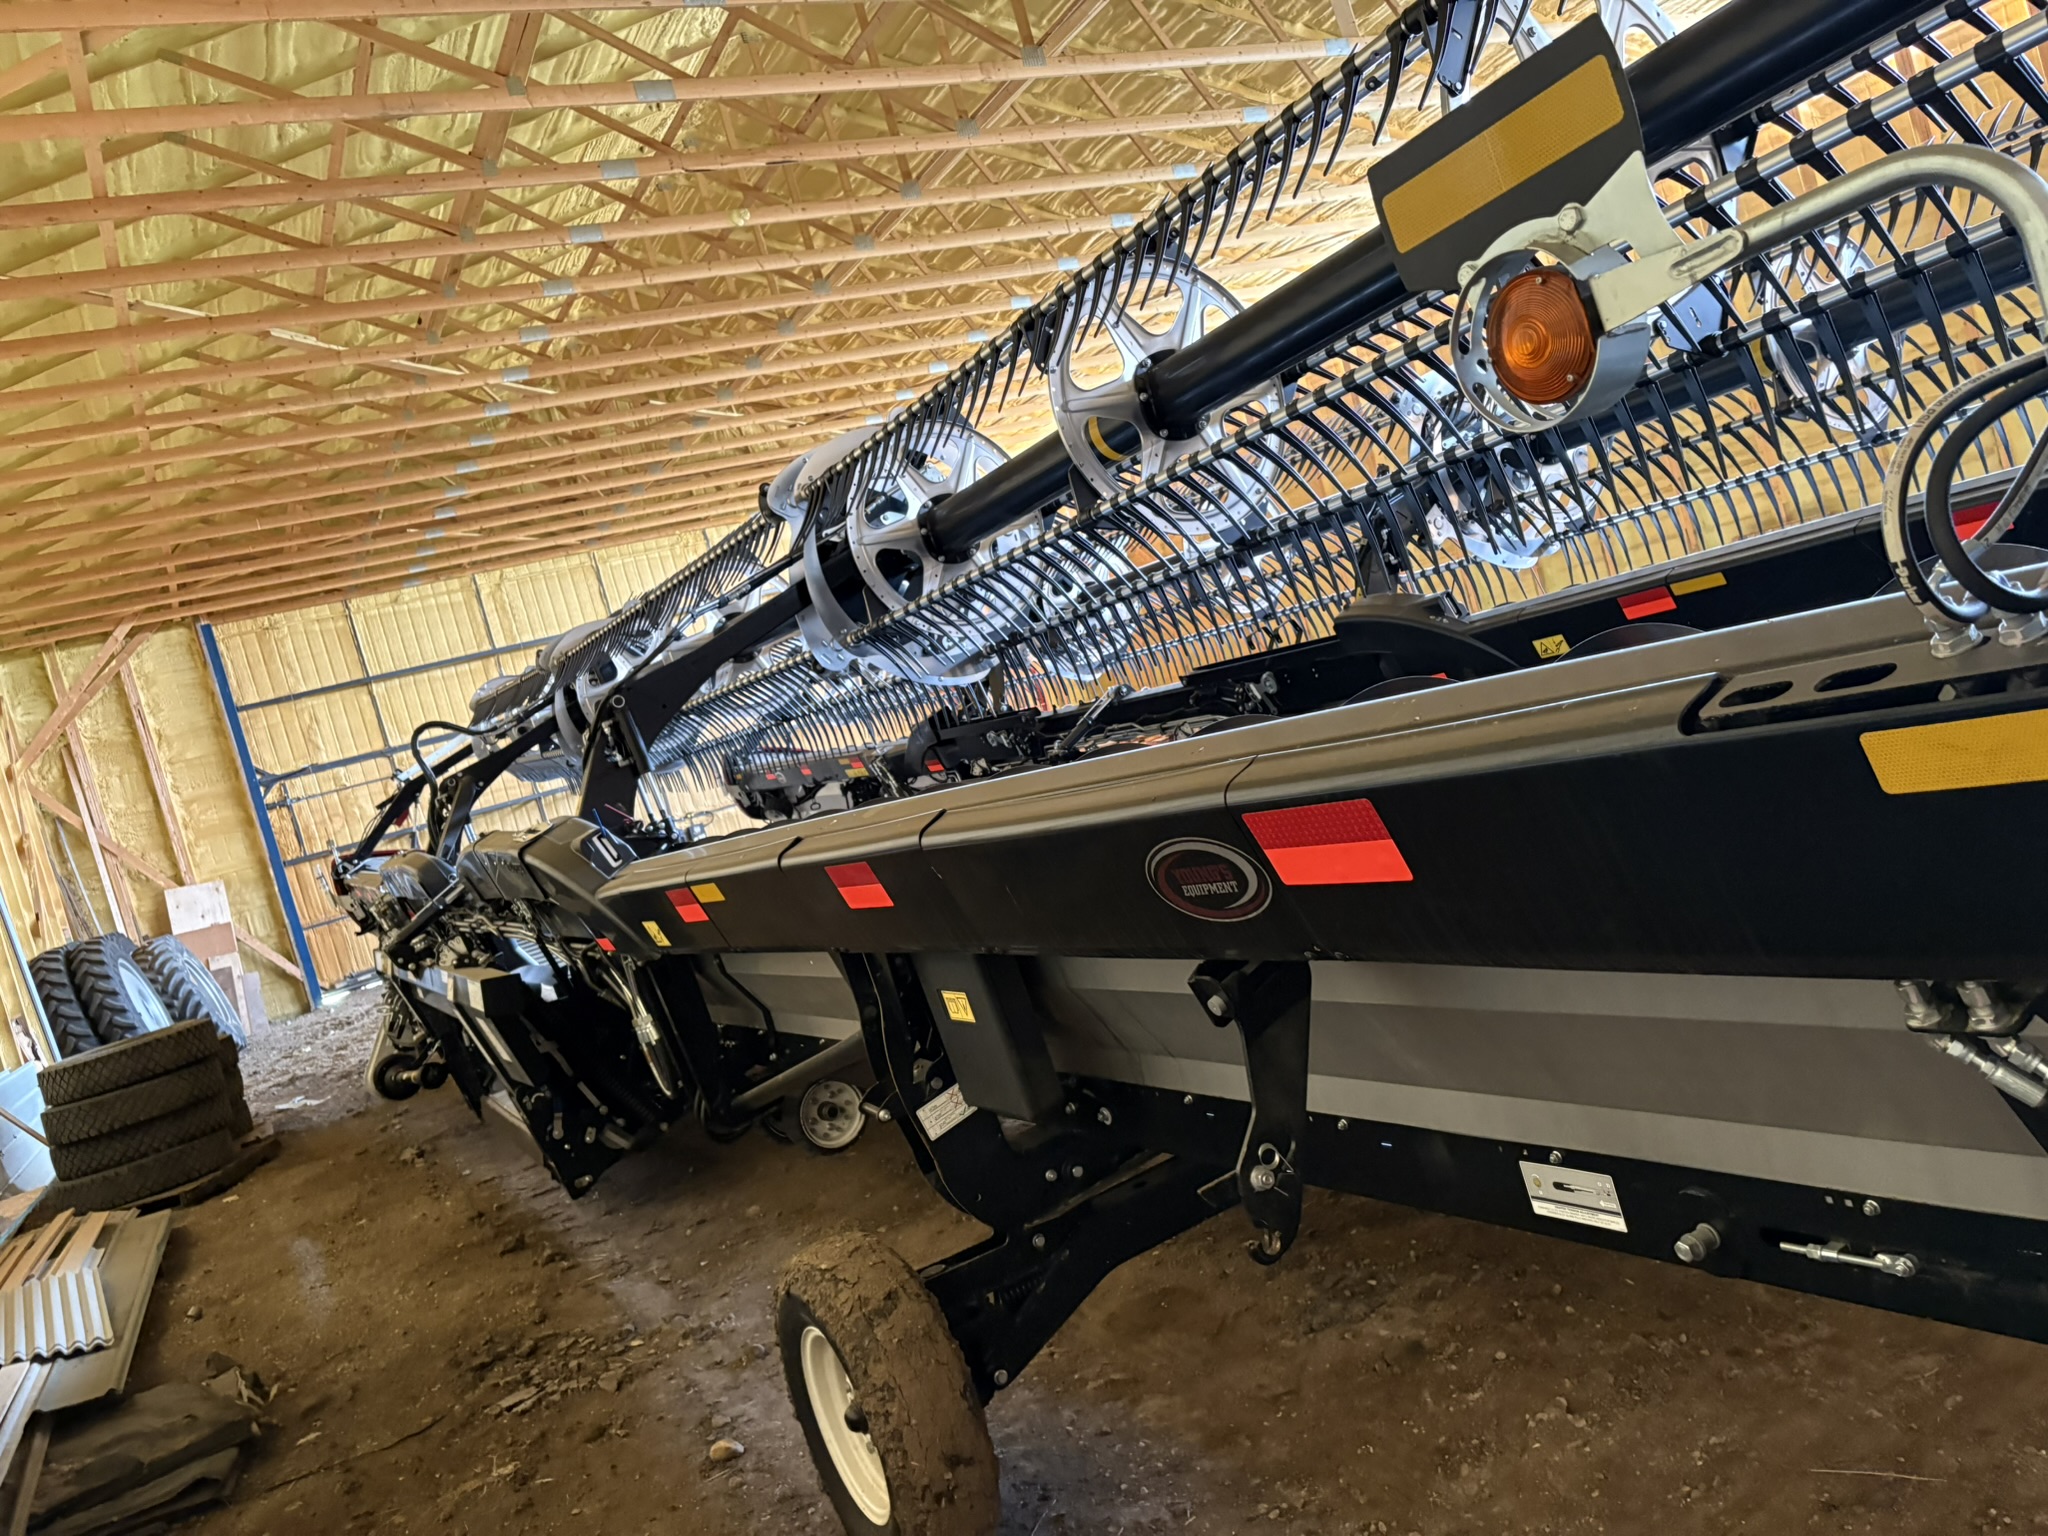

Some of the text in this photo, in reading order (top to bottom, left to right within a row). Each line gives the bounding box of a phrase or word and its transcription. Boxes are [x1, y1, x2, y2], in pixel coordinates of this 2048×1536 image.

[1895, 566, 1922, 603] Parker
[1171, 864, 1234, 885] YOUNG'S
[1182, 881, 1239, 897] EQUIPMENT
